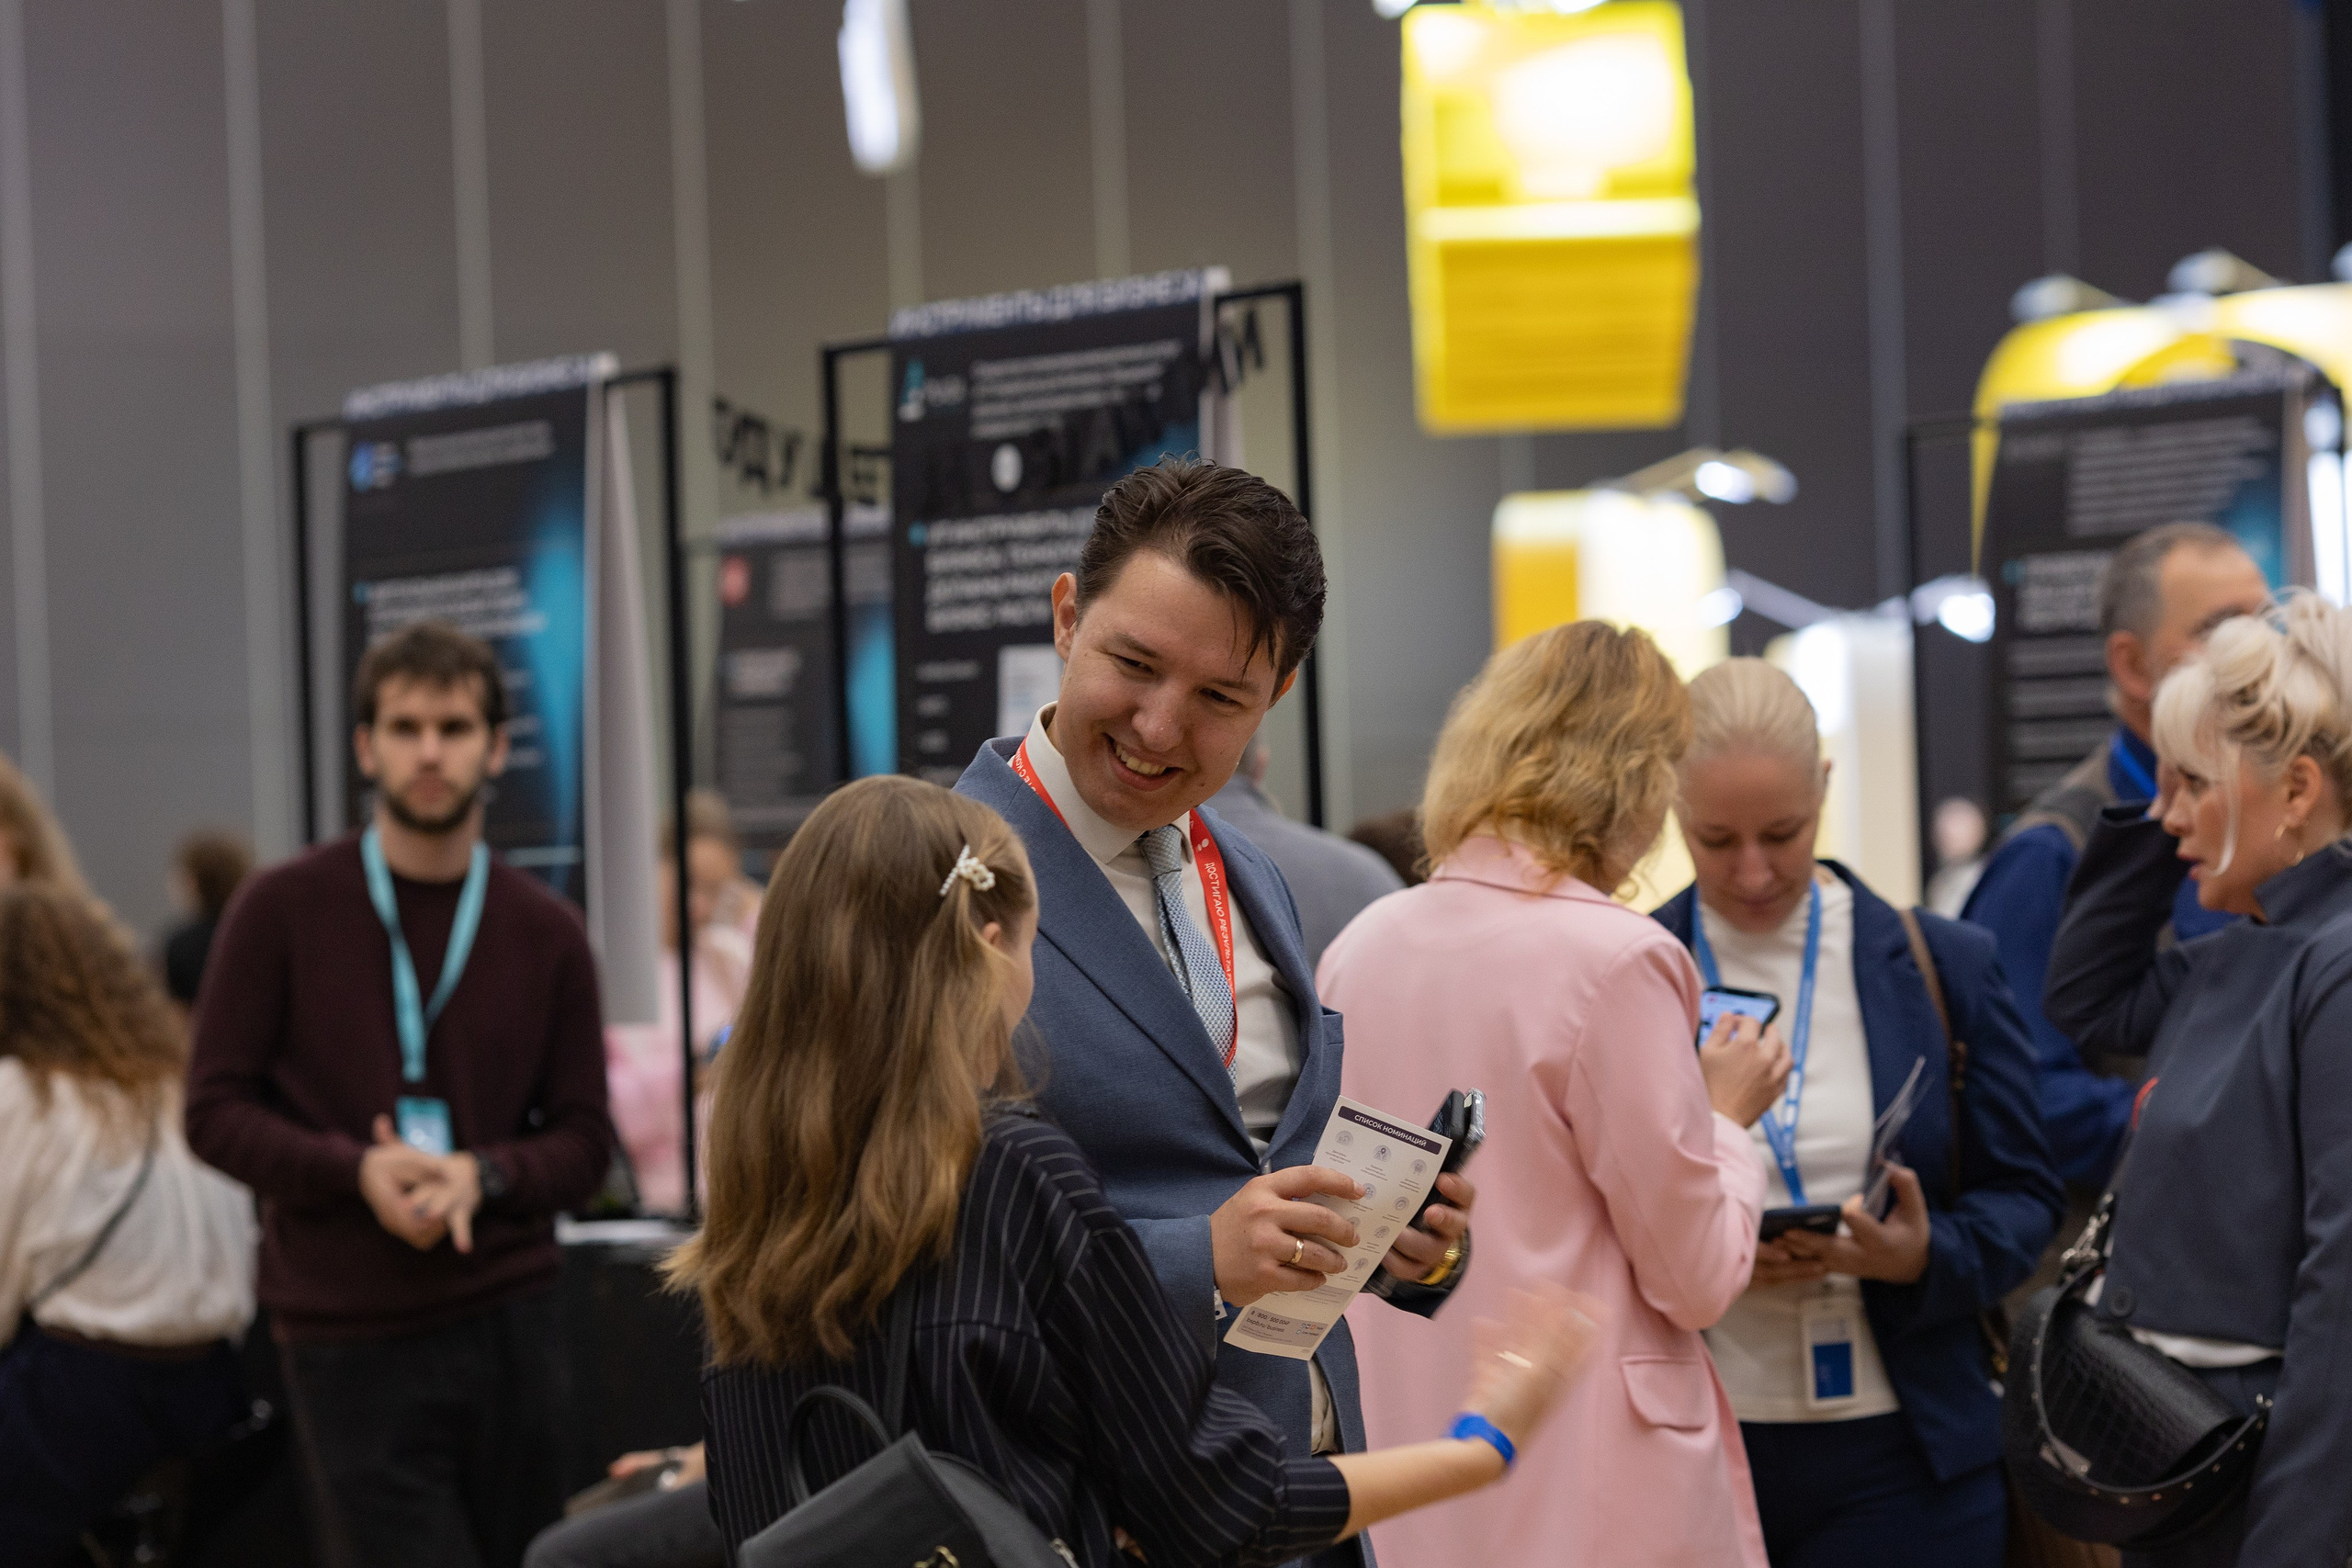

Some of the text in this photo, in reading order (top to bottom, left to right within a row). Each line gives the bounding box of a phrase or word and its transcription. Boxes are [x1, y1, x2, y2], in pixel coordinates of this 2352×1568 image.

[1204, 862, 1225, 917] ДОСТИГАЮ
[1354, 1114, 1427, 1147] СПИСОК НОМИНАЦИЙ
